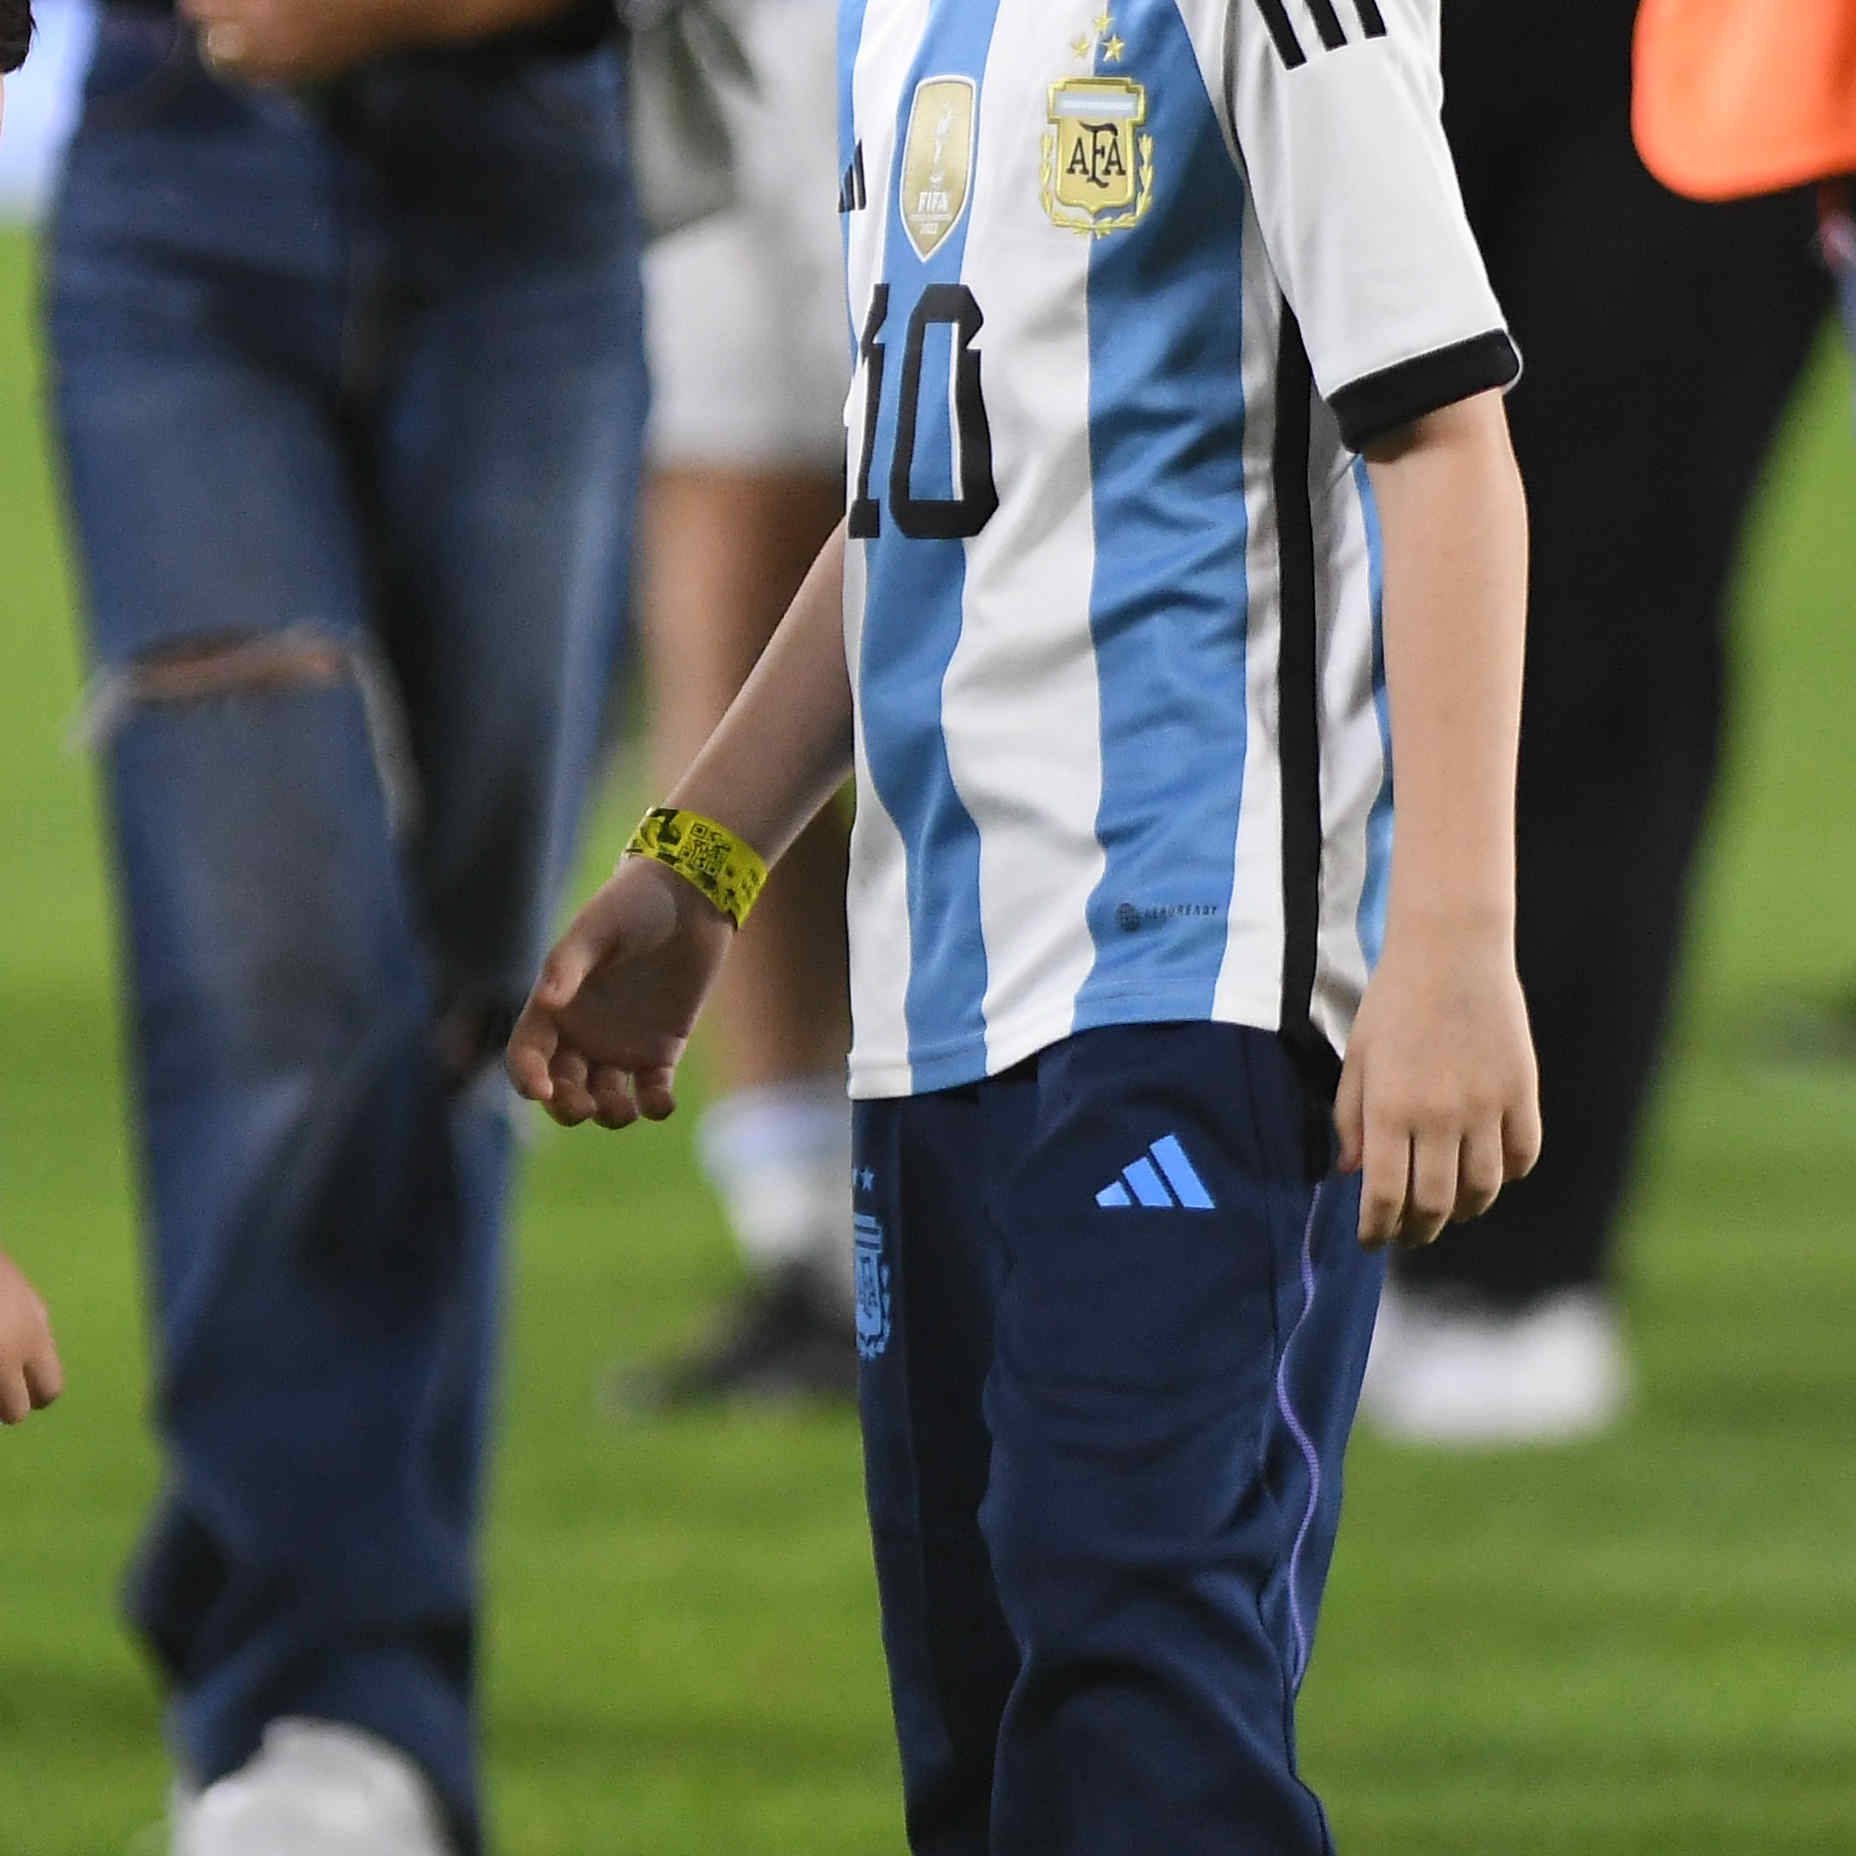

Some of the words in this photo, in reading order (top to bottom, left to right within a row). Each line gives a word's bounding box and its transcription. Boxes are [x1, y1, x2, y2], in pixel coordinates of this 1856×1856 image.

[1066, 120, 1126, 188] AFA
[918, 191, 948, 213] FIFA
[847, 282, 1000, 540] 10
